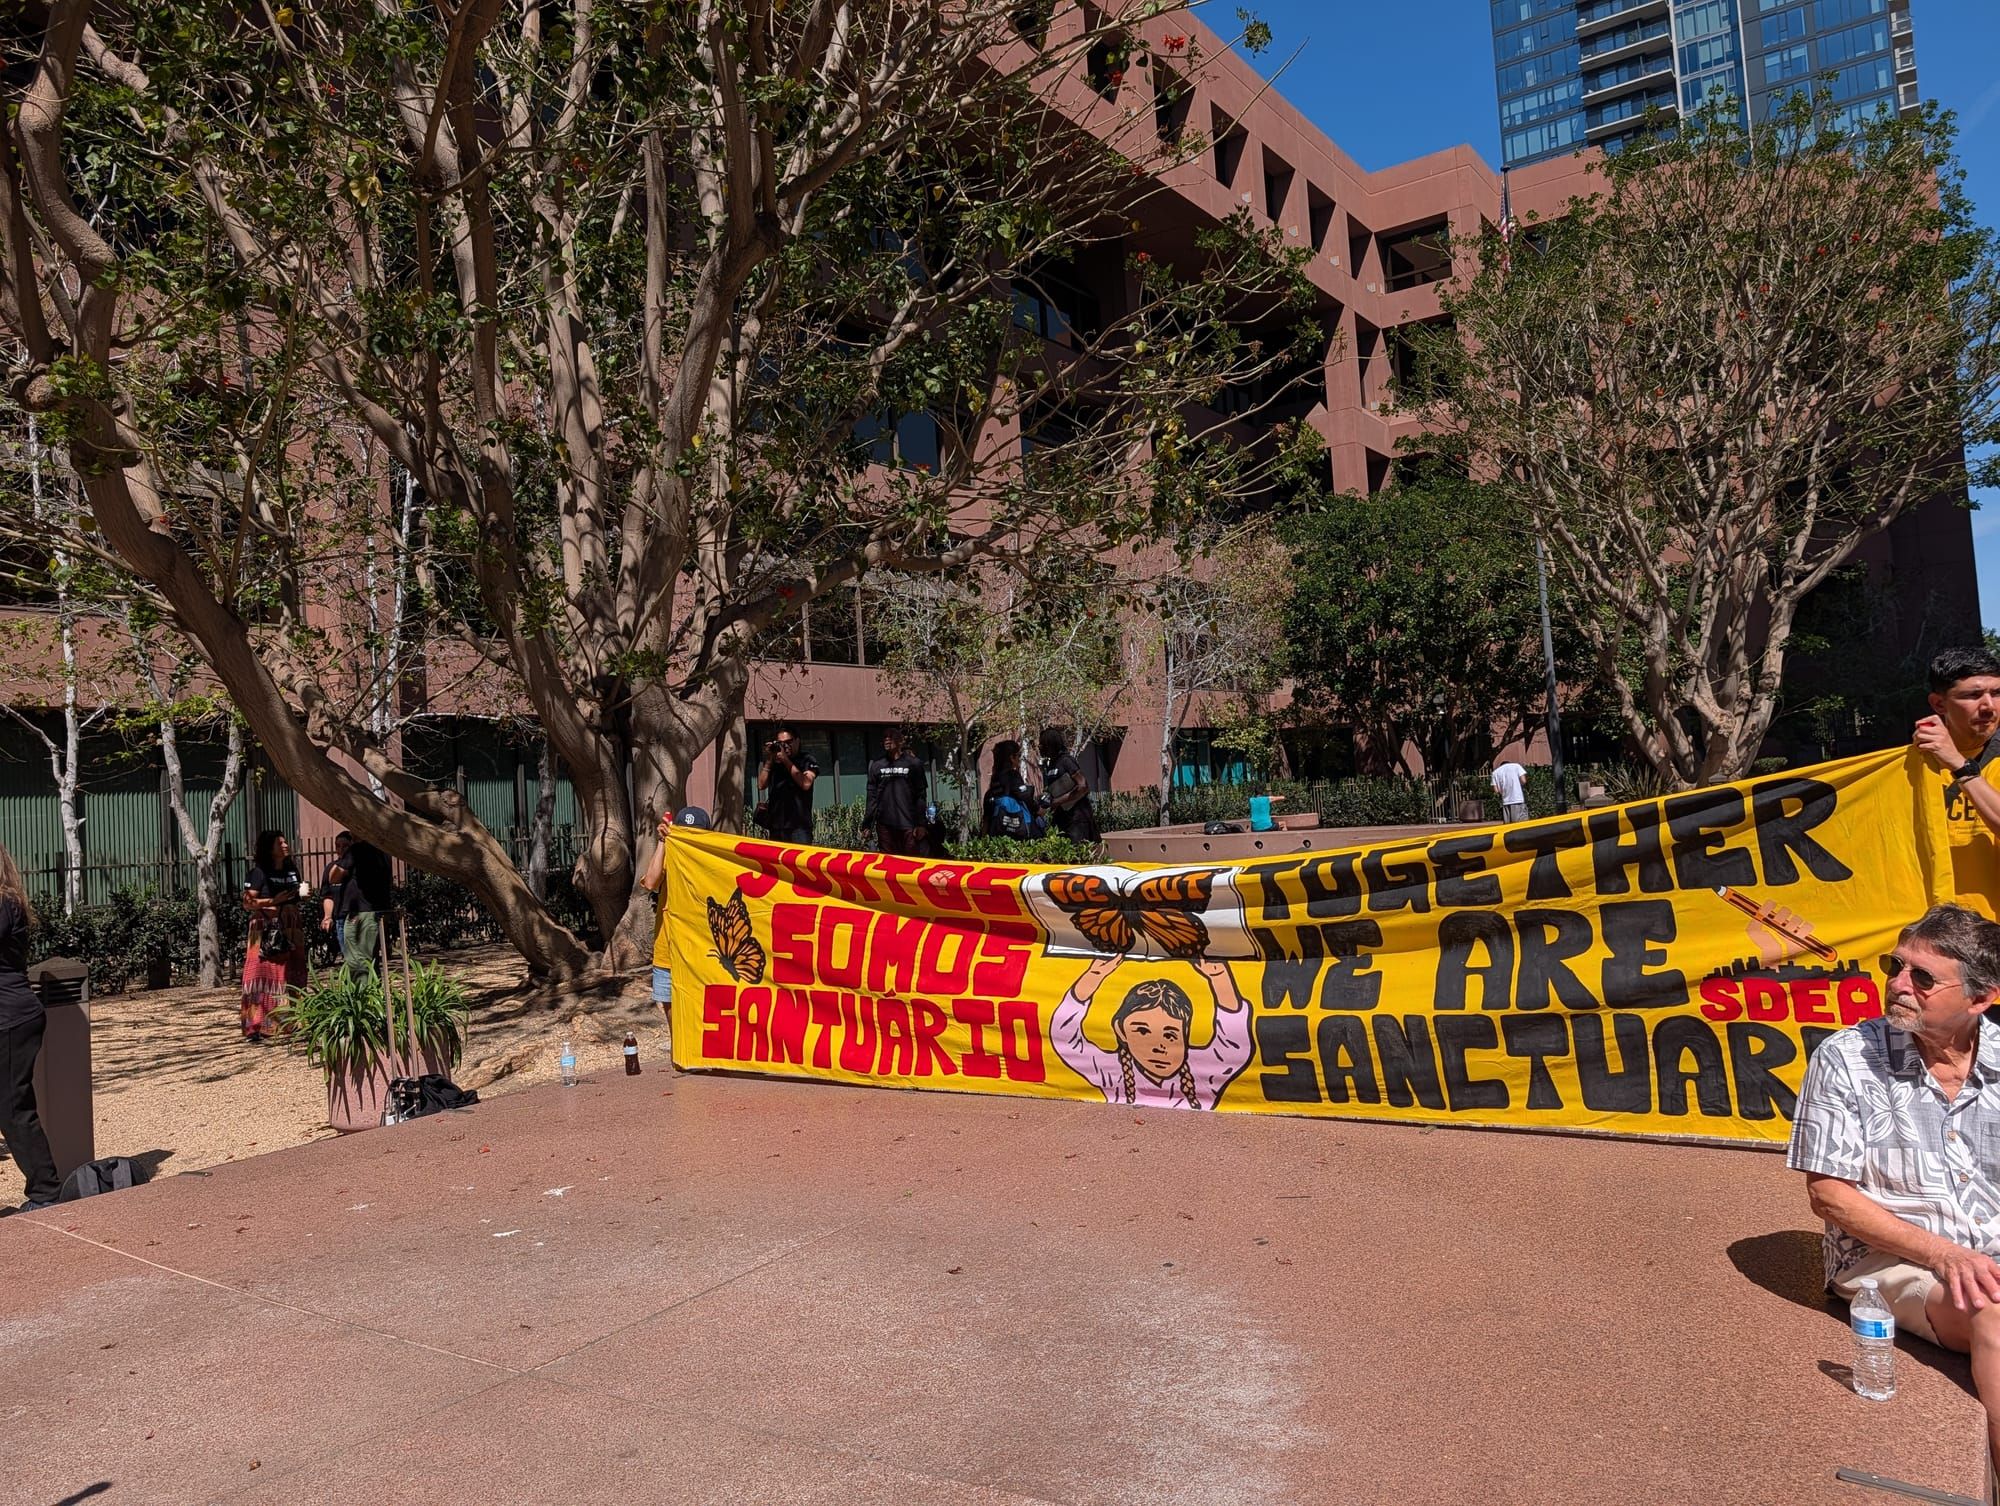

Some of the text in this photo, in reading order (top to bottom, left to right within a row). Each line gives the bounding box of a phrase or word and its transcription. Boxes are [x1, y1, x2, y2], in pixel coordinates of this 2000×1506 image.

[734, 841, 1030, 916] JUNTOS
[1049, 871, 1213, 904] ICE OUT
[1244, 777, 1853, 921] TOGETHER
[771, 902, 1039, 998] SOMOS
[1251, 900, 1689, 1012] WE ARE
[702, 984, 1046, 1083] SANTUARIO
[1699, 976, 1883, 1026] SDEA
[1255, 1012, 1842, 1122] SANCTUAR
